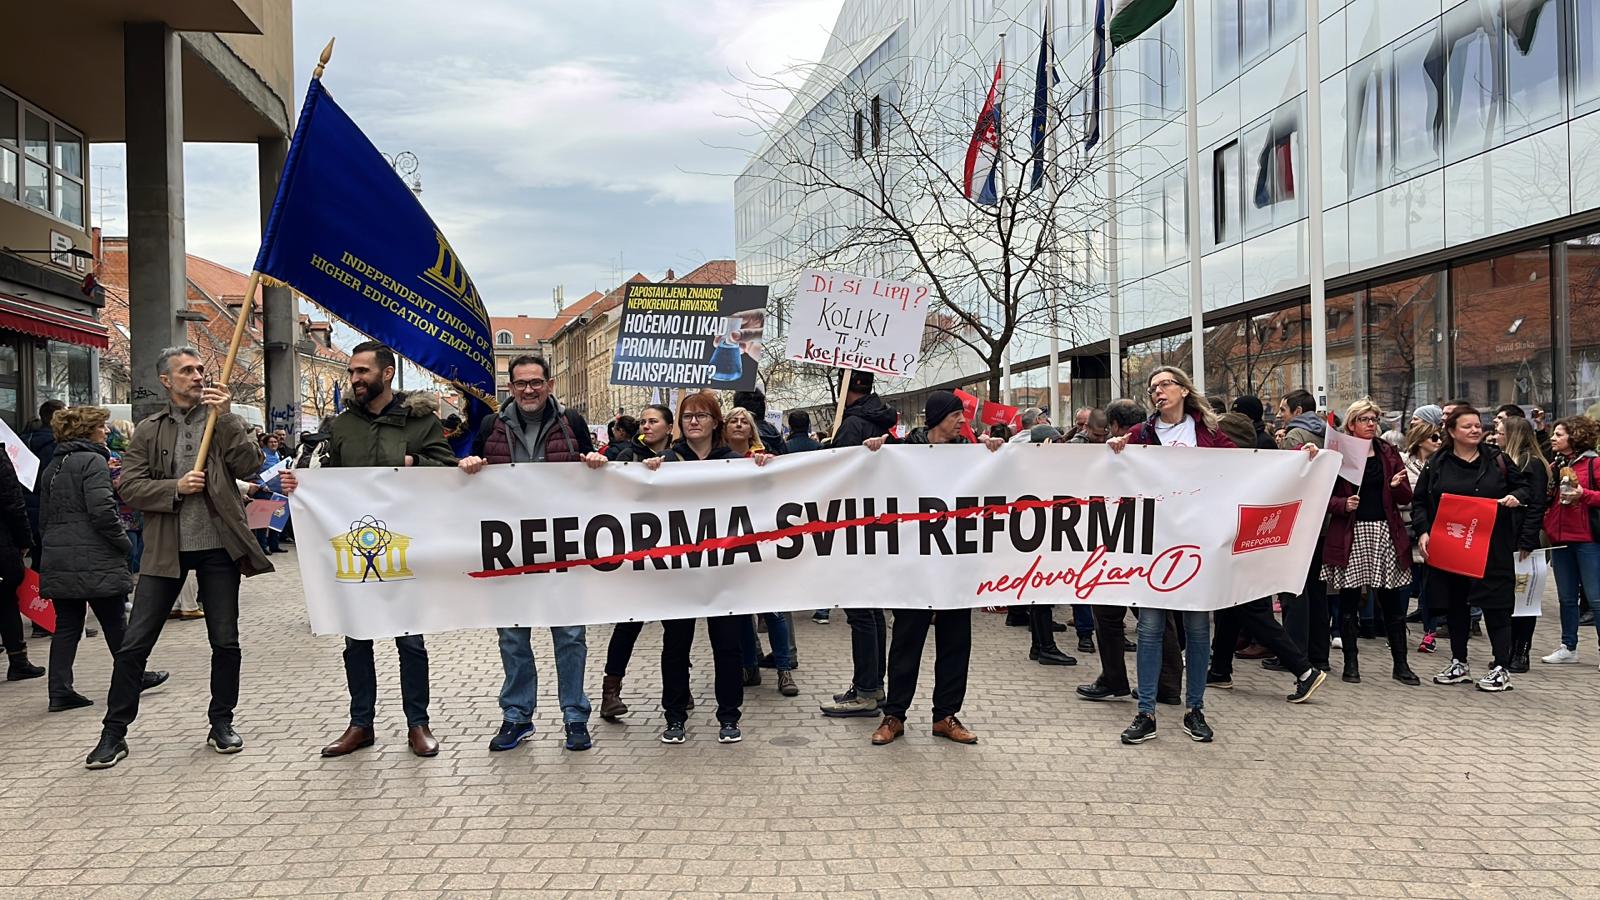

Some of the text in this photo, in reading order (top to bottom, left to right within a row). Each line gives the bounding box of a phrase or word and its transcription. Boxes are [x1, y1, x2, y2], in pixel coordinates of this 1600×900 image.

[340, 250, 490, 351] INDEPENDENT UNION OF
[627, 298, 720, 312] NEPOKRENUTA HRVATSKA.
[629, 286, 724, 301] ZAPOSTAVLJENA ZNANOST,
[310, 253, 494, 377] HIGHER EDUCATION EMPLOYE
[624, 310, 728, 336] HOĆEMO LI IKAD
[817, 297, 890, 337] KOLIKI
[620, 337, 706, 360] PROMIJENITI
[616, 361, 717, 385] TRANSPARENT?
[480, 494, 1155, 575] REFORMA SVIH REFORMI
[1240, 535, 1282, 549] PREPOROD
[1464, 518, 1478, 549] PREPOROD
[976, 545, 1148, 600] nedovoljan
